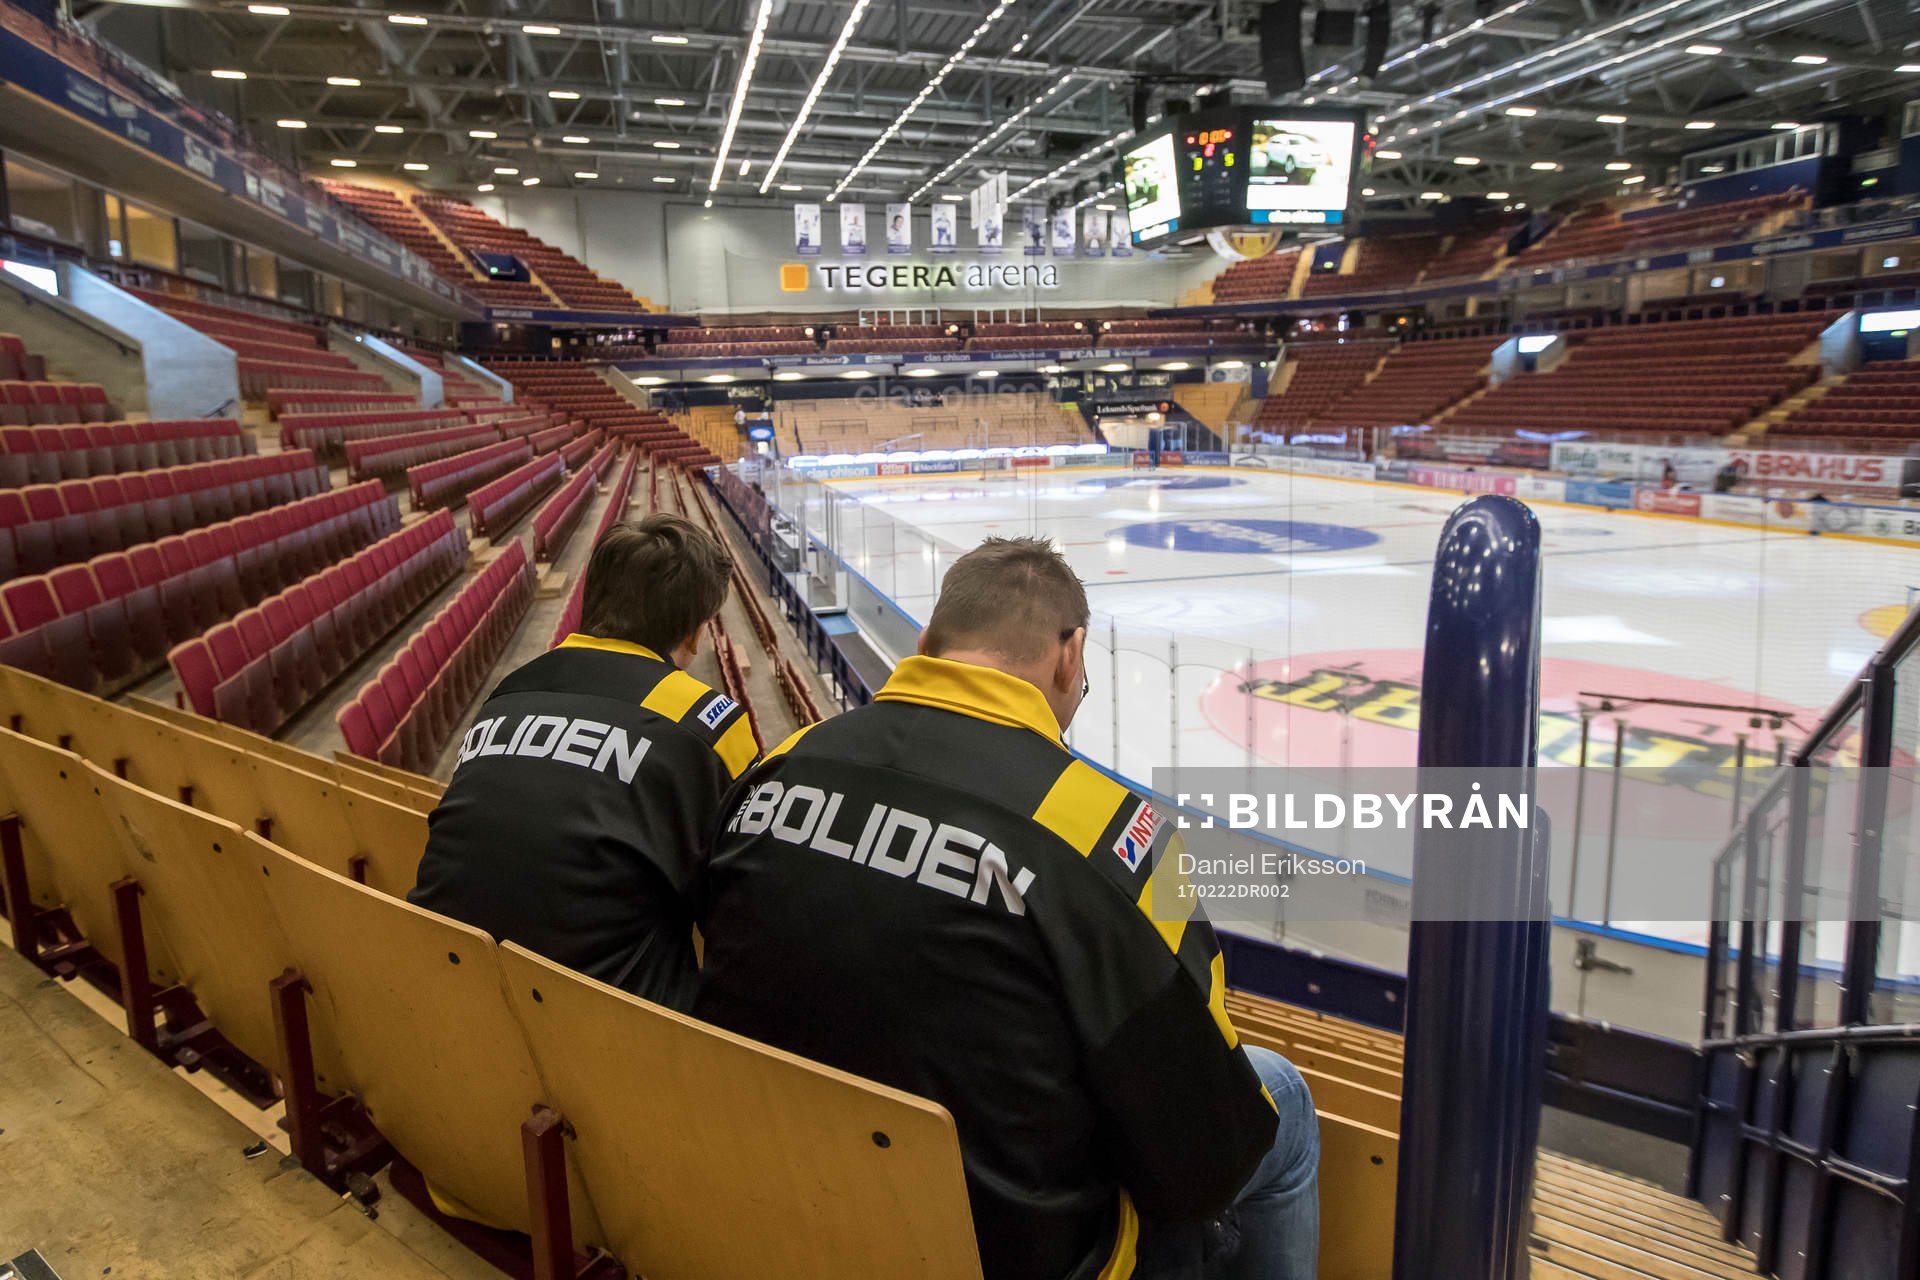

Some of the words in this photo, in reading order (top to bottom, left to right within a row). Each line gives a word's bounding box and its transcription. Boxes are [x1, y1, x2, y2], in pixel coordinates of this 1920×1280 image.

[967, 264, 1058, 287] arena
[453, 714, 652, 784] OLIDEN
[740, 781, 1036, 916] BOLIDEN
